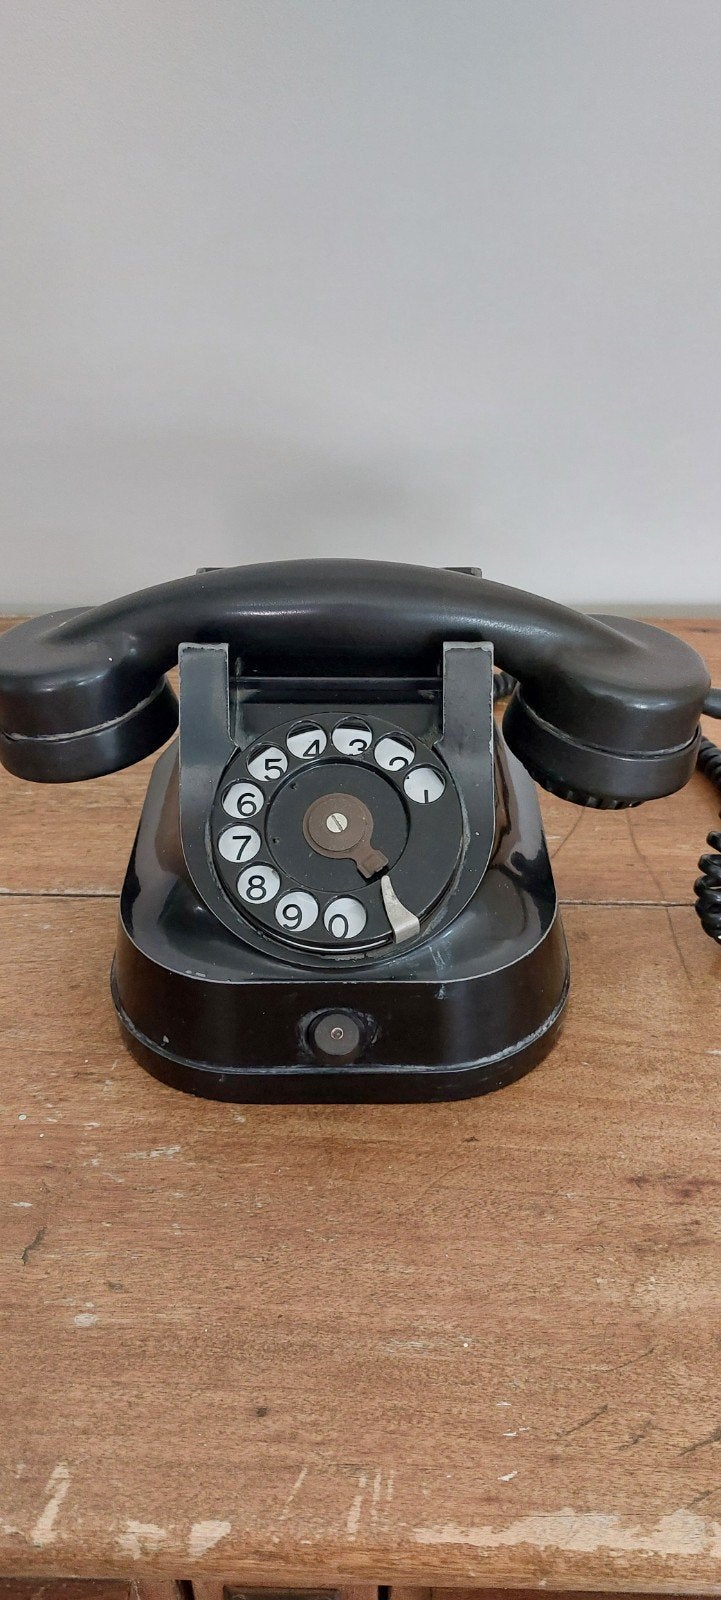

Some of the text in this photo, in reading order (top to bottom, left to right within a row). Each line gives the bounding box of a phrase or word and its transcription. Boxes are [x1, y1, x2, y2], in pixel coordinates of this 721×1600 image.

[303, 739, 321, 759] 4
[349, 738, 369, 755] 3
[264, 758, 284, 780] 5
[236, 792, 257, 817] 6
[232, 835, 252, 861] 7
[245, 875, 266, 901] 8
[282, 904, 303, 930] 9
[328, 913, 349, 939] 0
